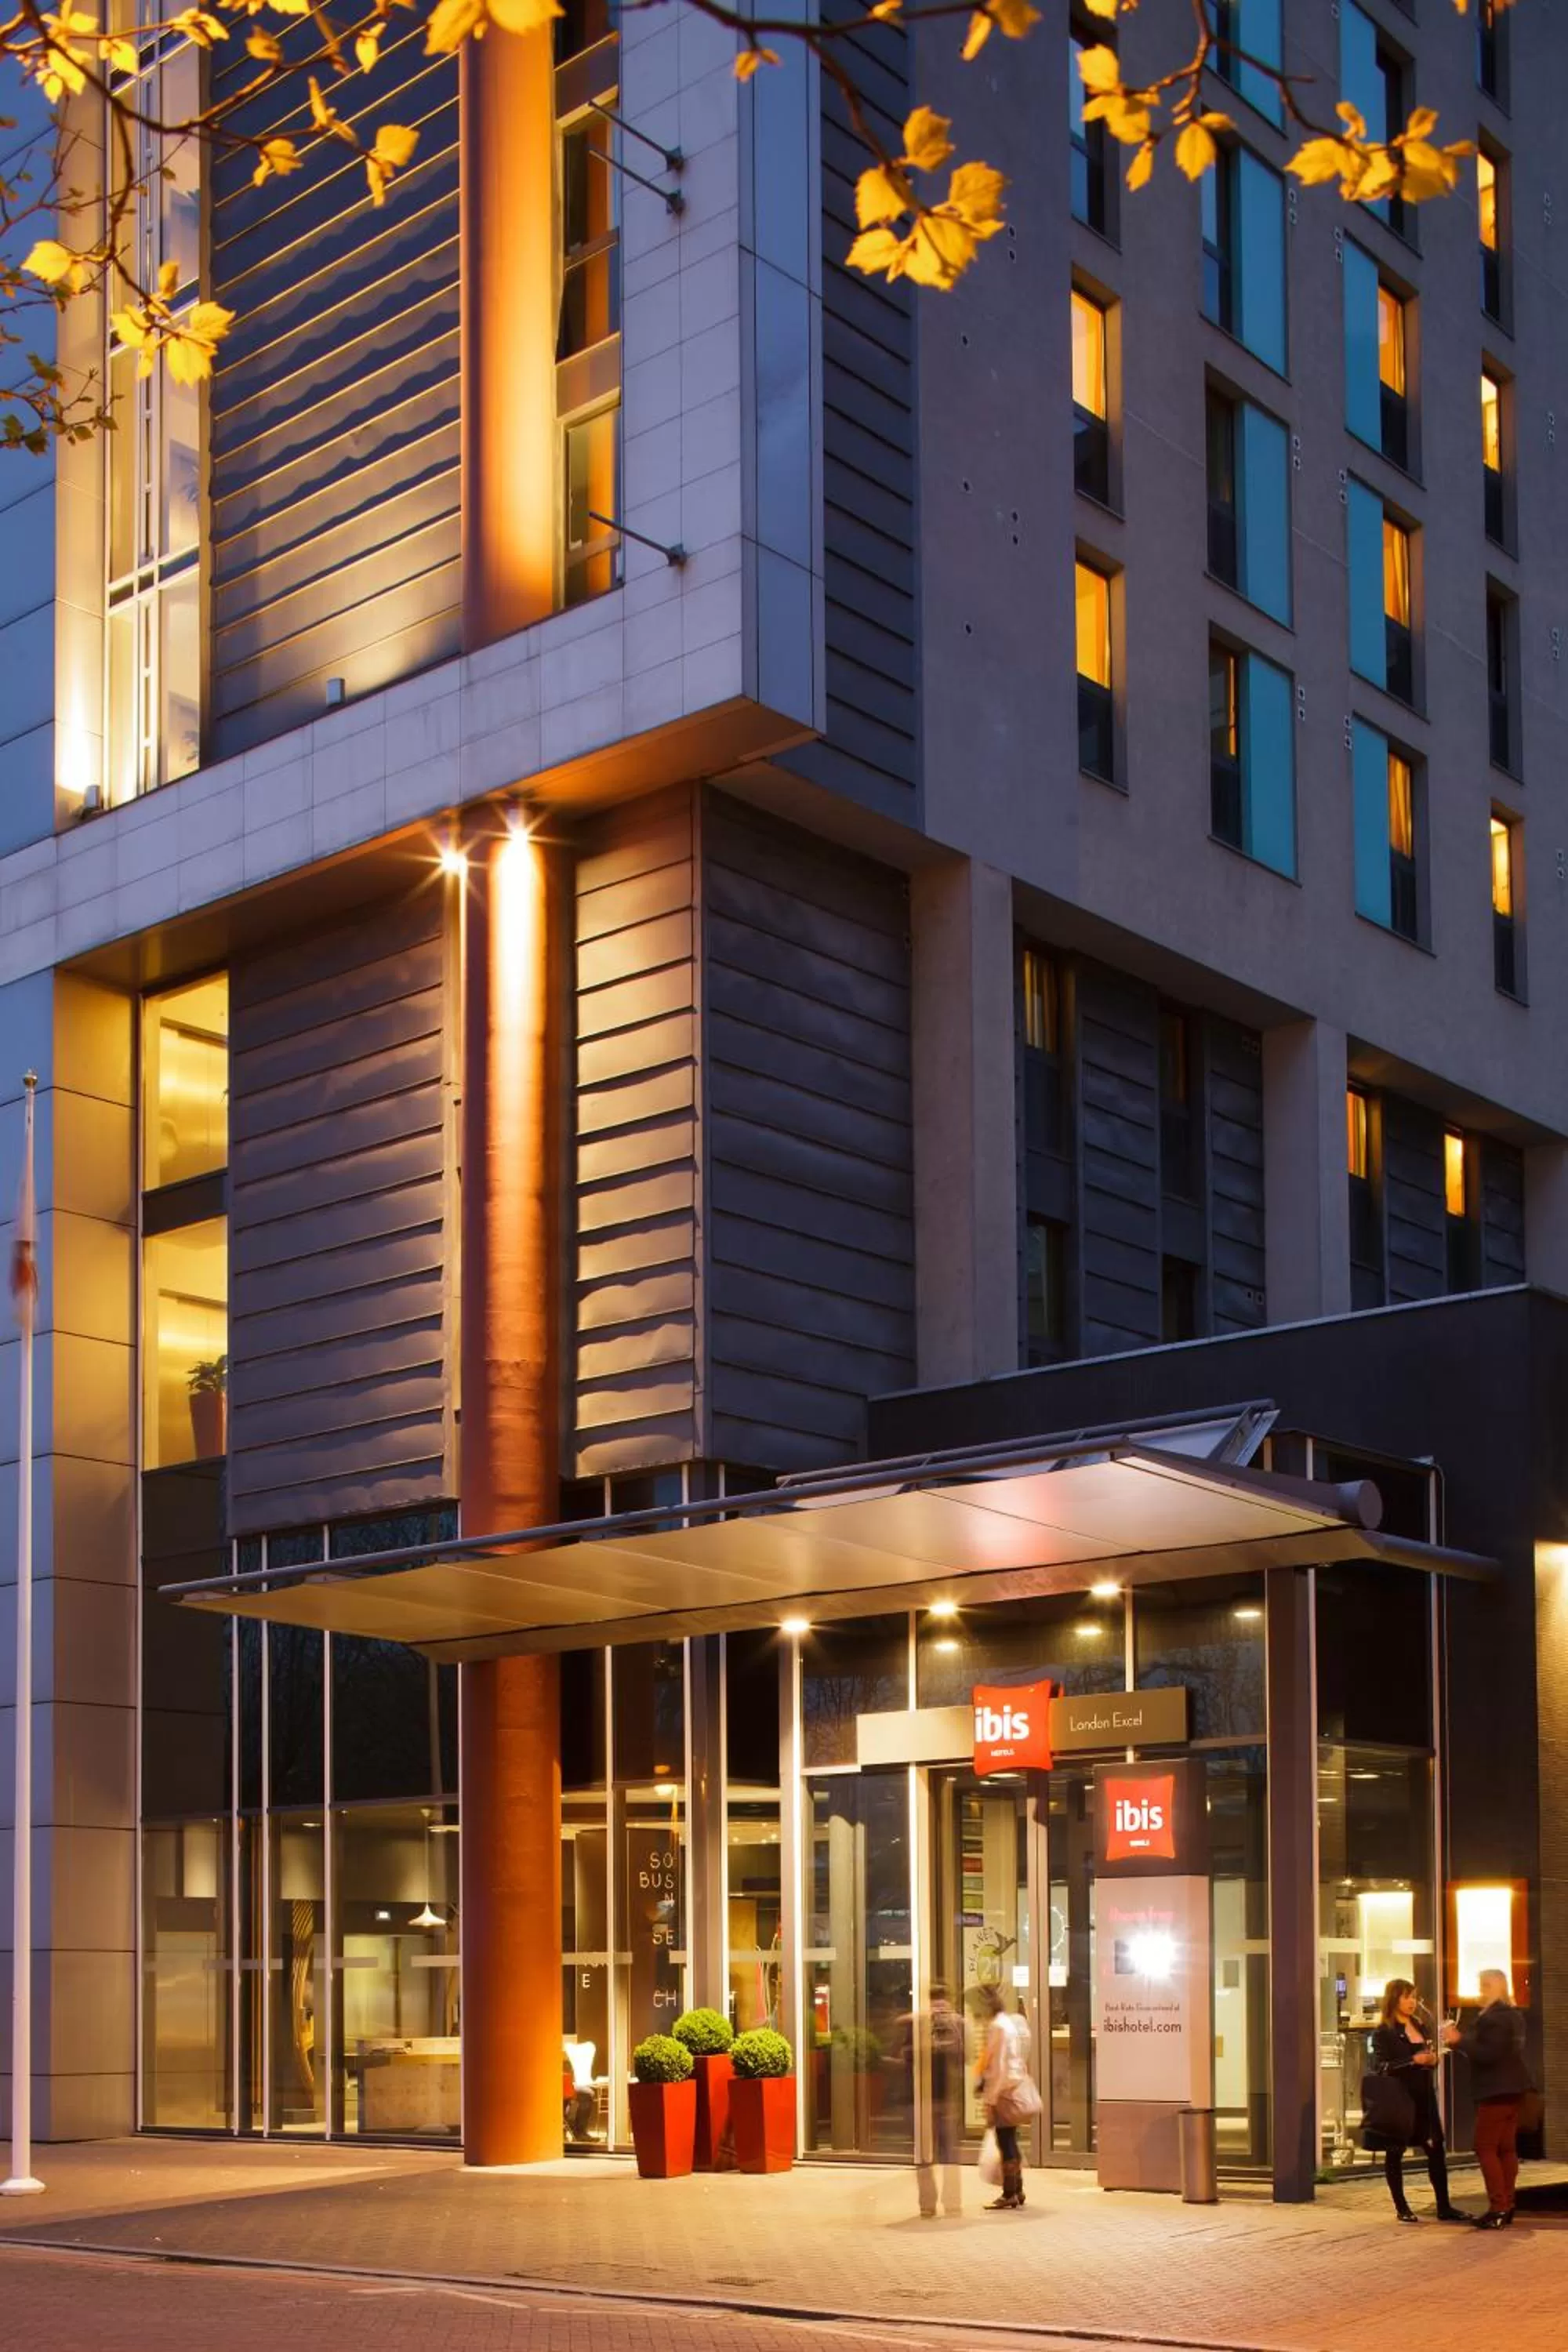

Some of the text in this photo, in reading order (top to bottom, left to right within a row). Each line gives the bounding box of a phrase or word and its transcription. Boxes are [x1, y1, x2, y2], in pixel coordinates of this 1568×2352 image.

[975, 1705, 1029, 1743] ibis
[1069, 1709, 1143, 1731] London Excel
[1116, 1799, 1163, 1832] ibis
[1103, 2016, 1182, 2033] ibishotel.com
